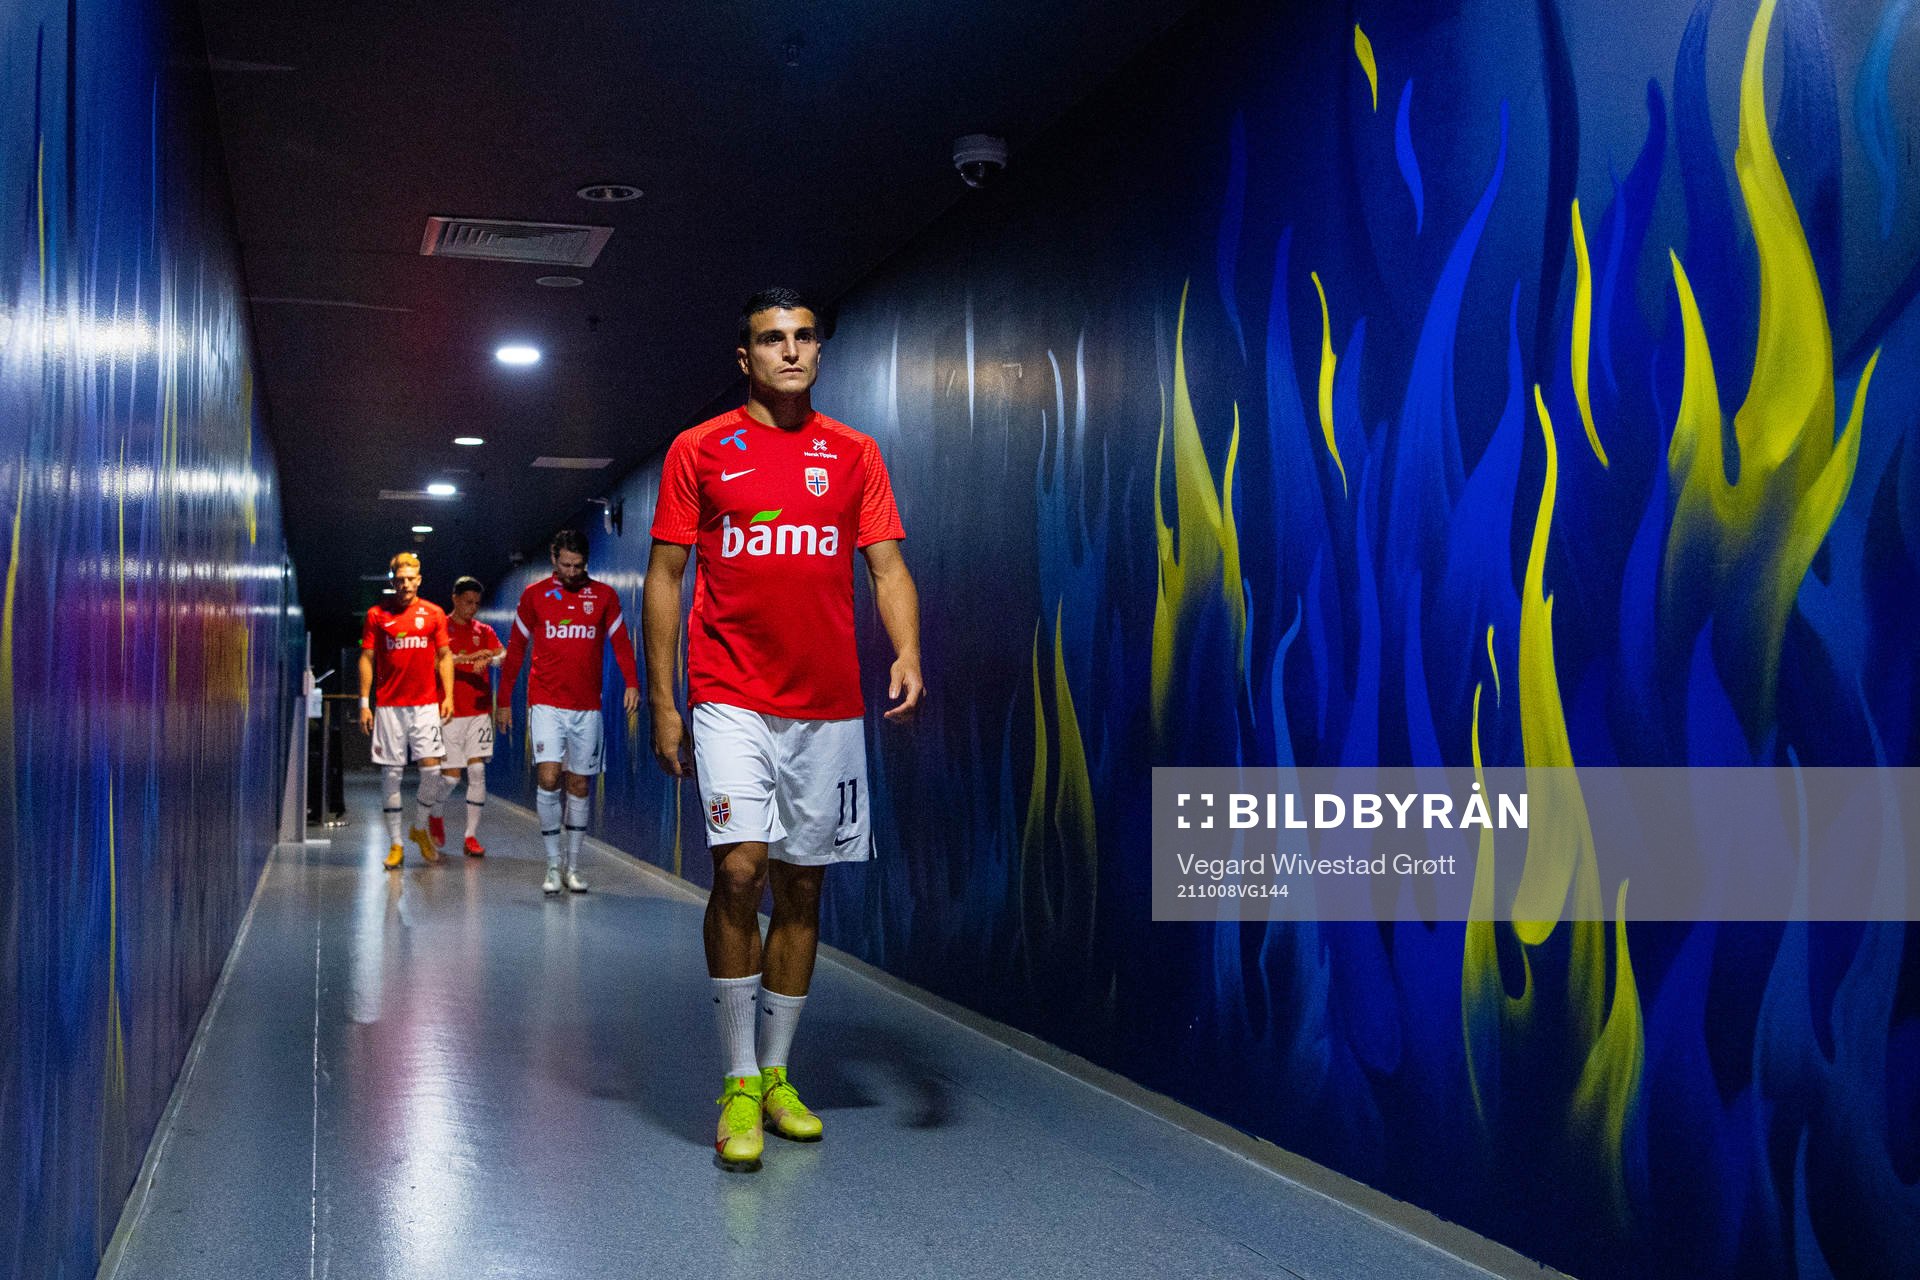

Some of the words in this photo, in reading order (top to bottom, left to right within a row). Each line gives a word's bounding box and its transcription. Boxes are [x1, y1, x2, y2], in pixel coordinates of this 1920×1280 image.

[721, 514, 839, 558] bama
[545, 620, 597, 639] bama
[386, 633, 428, 650] bama
[478, 727, 492, 743] 22
[837, 778, 857, 826] 11
